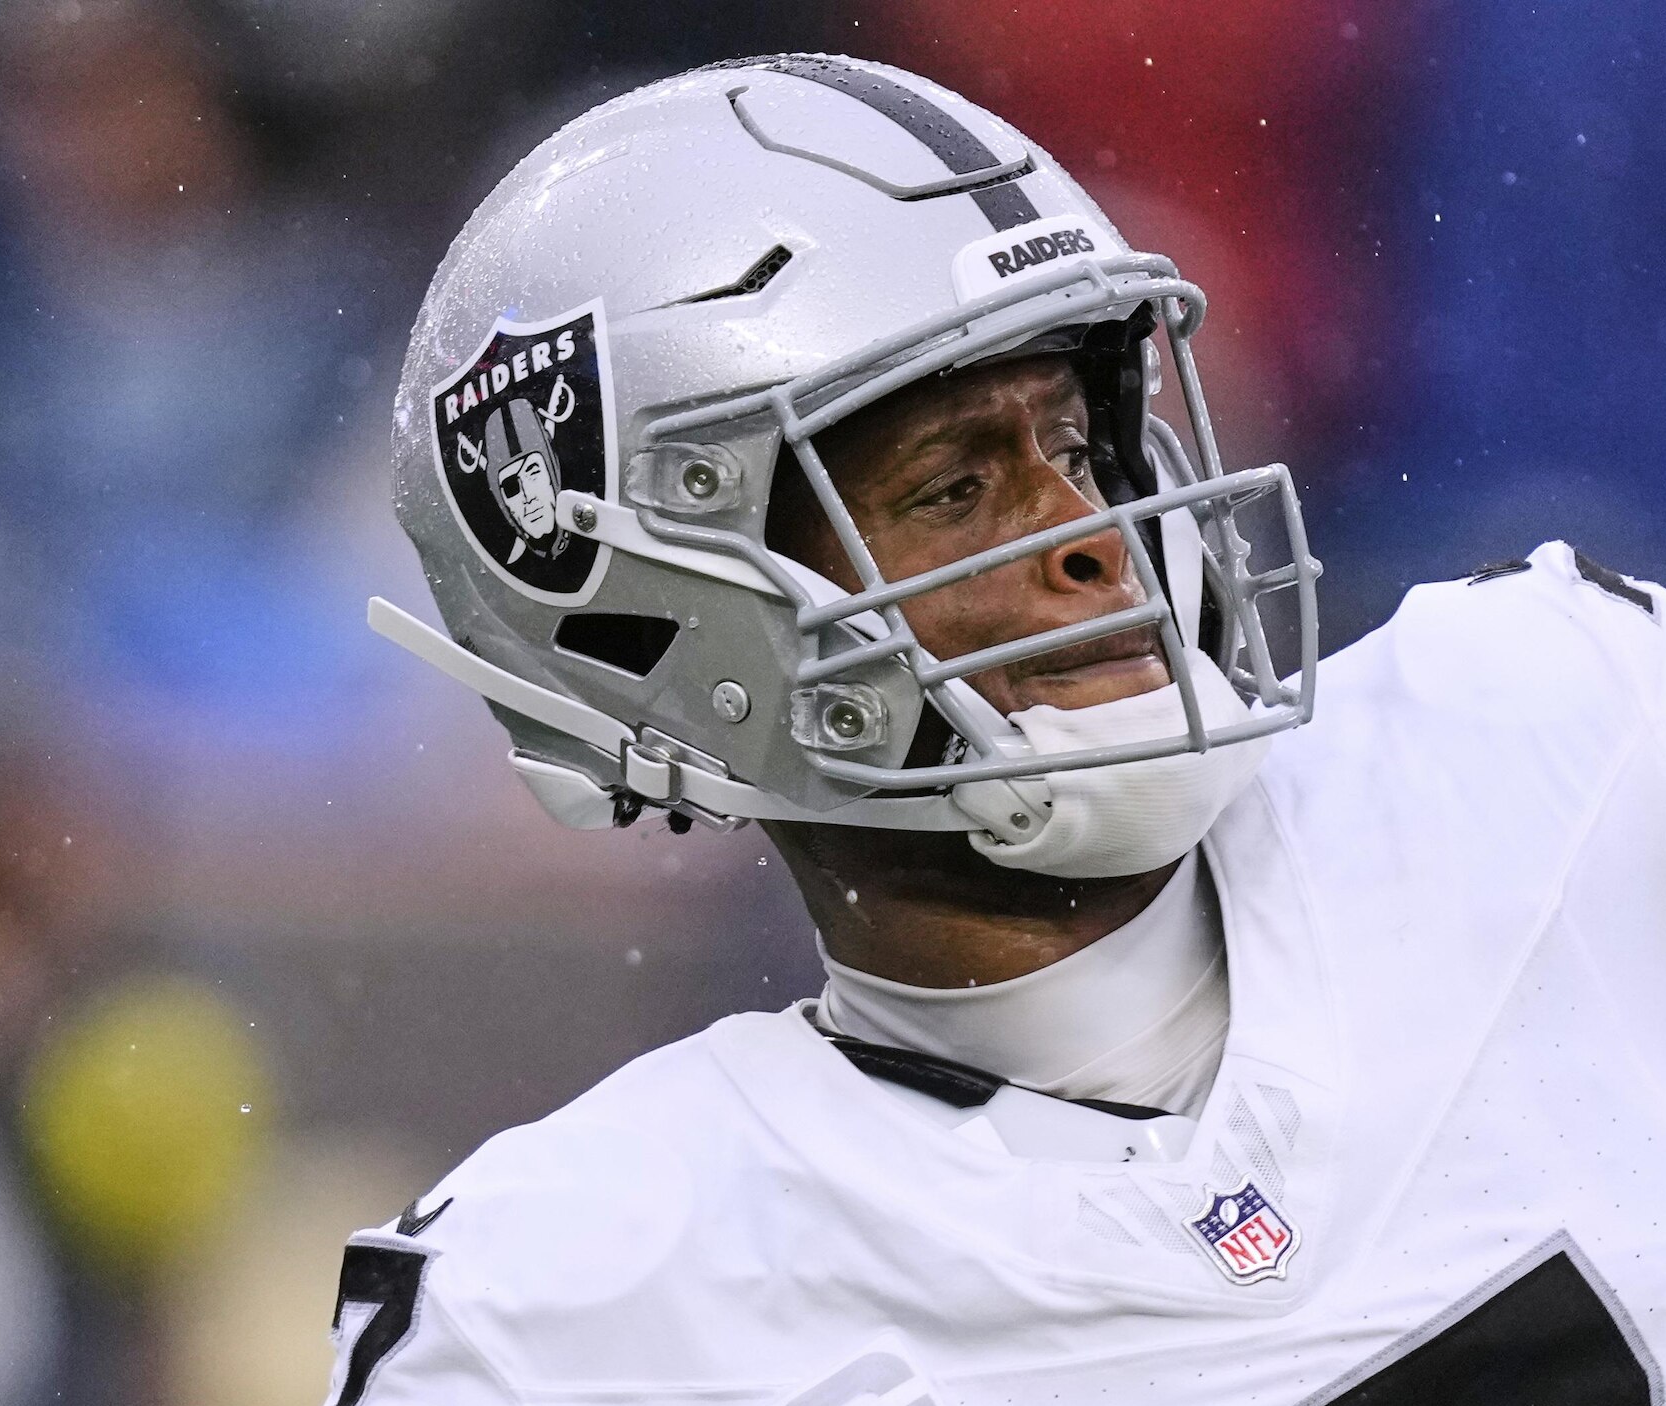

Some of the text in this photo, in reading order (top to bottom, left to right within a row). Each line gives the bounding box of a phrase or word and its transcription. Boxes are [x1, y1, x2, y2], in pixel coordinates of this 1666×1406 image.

[987, 228, 1096, 278] RAIDERS
[444, 329, 576, 425] RAIDERS
[1219, 1215, 1287, 1270] NFL
